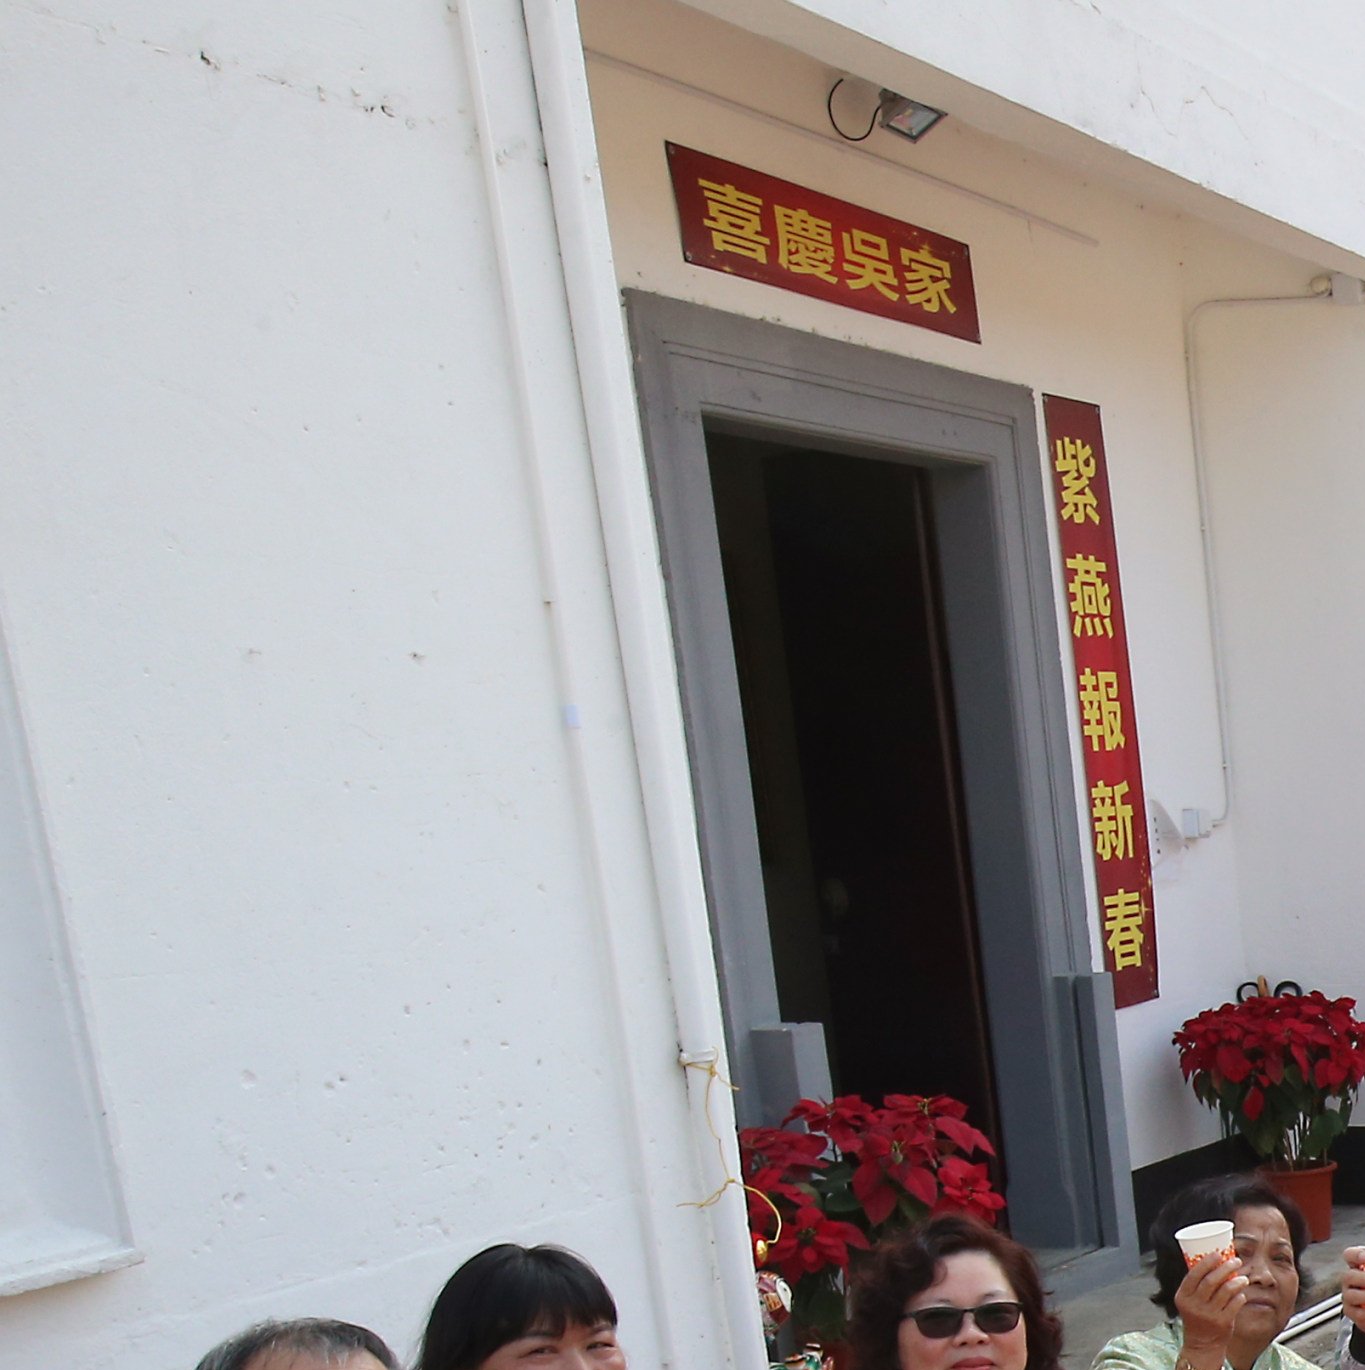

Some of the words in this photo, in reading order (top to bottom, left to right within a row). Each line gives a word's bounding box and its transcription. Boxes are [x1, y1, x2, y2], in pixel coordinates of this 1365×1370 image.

[698, 178, 958, 316] 喜慶吳家
[1054, 438, 1147, 971] 紫燕報新春
